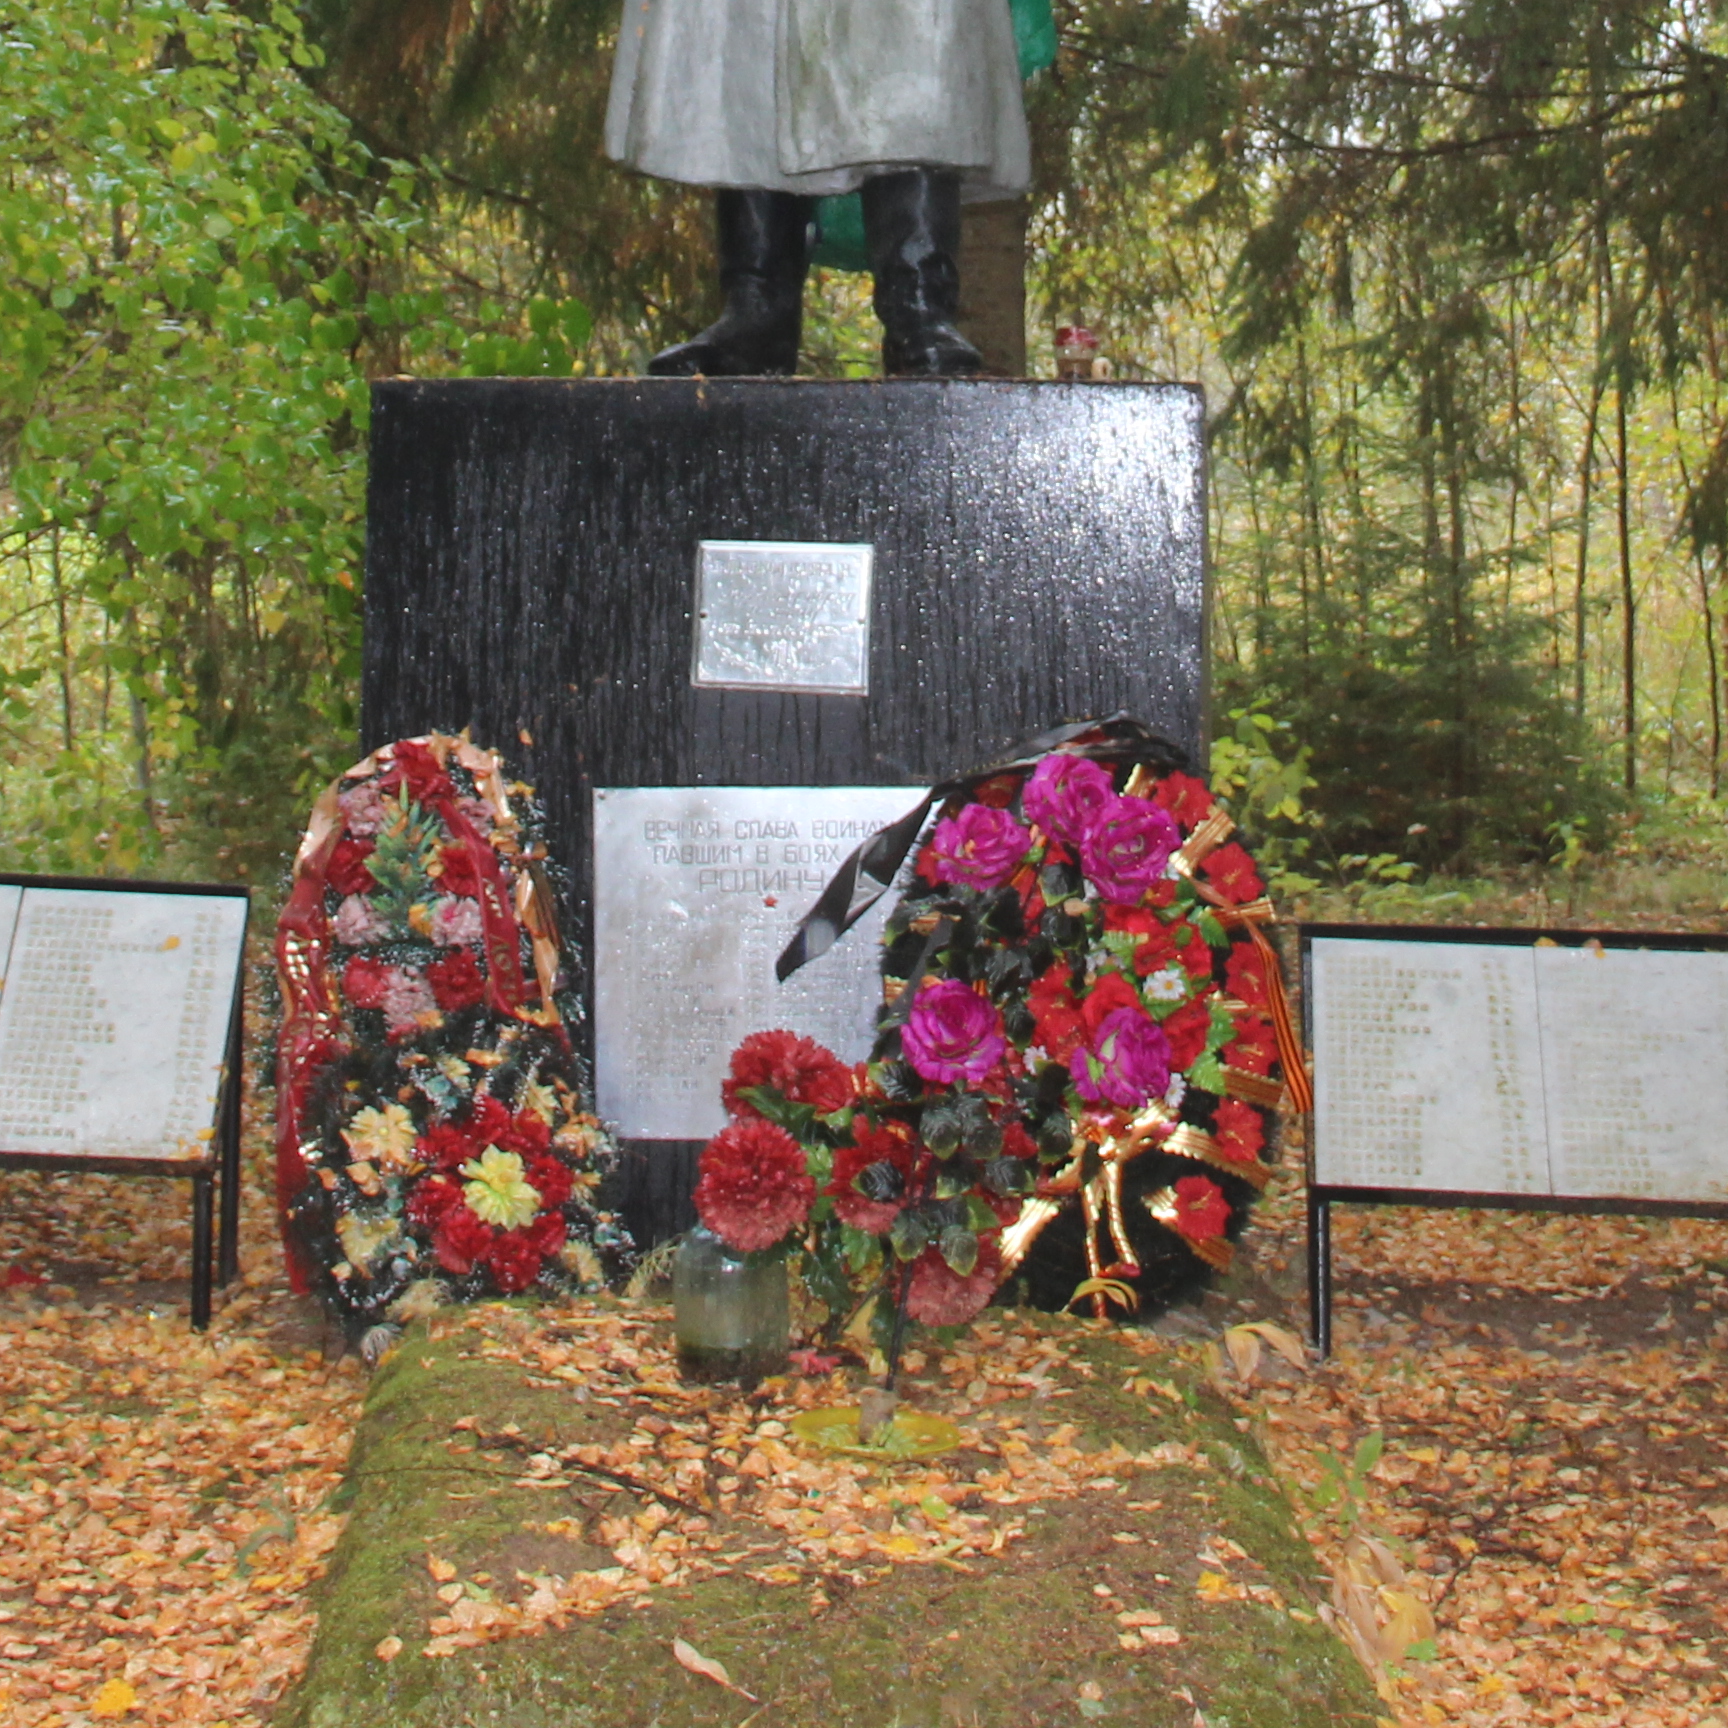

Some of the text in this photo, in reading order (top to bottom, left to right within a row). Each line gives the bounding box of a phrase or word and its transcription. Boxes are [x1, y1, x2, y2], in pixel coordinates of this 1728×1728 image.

[644, 820, 721, 841] ВЕЧНАЯ
[734, 820, 799, 839] СЛАВА
[653, 845, 841, 865] ПАВШИМ В БОЯХ
[699, 869, 826, 894] РОДИНУ
